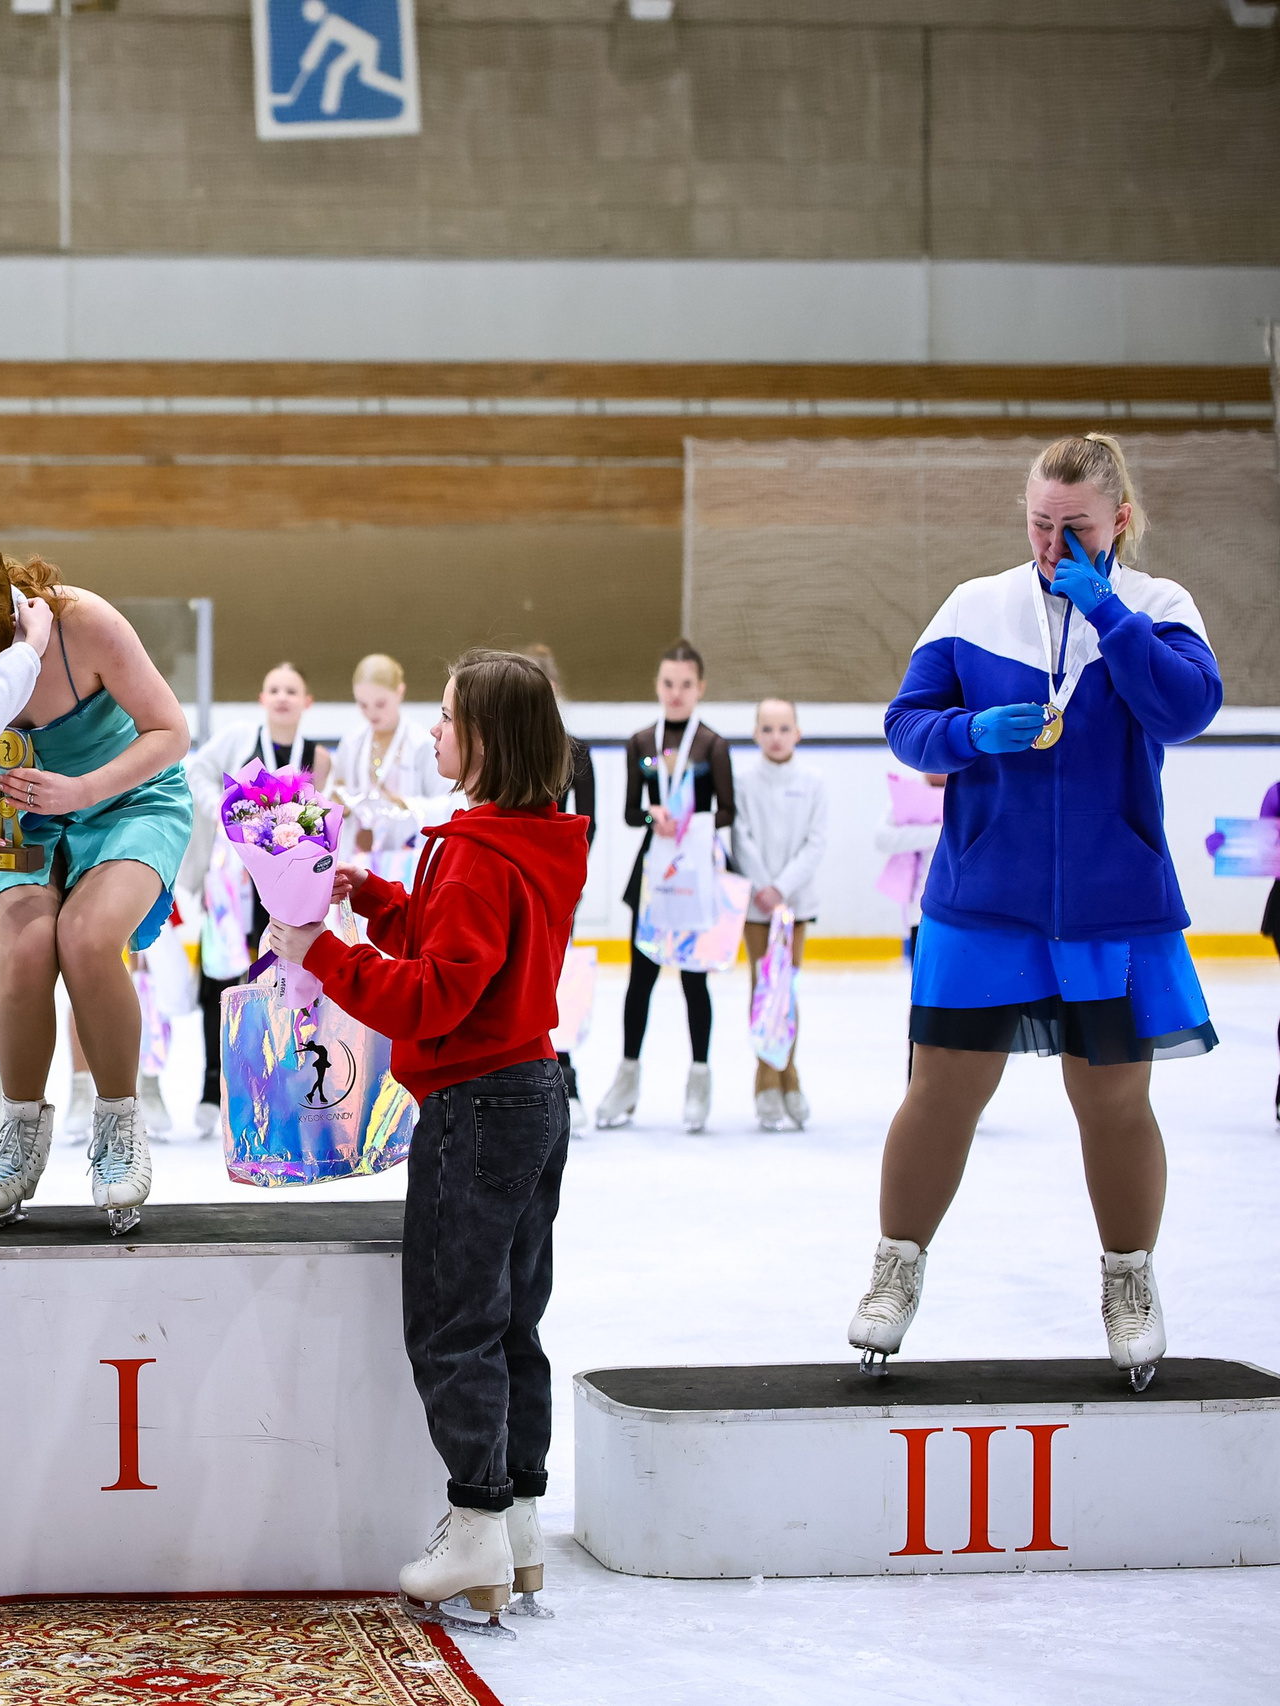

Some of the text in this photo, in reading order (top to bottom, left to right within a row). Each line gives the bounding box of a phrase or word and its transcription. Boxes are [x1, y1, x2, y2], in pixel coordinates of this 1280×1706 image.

[326, 1112, 354, 1121] CANDY
[100, 1358, 157, 1491] I
[889, 1424, 1070, 1557] III
